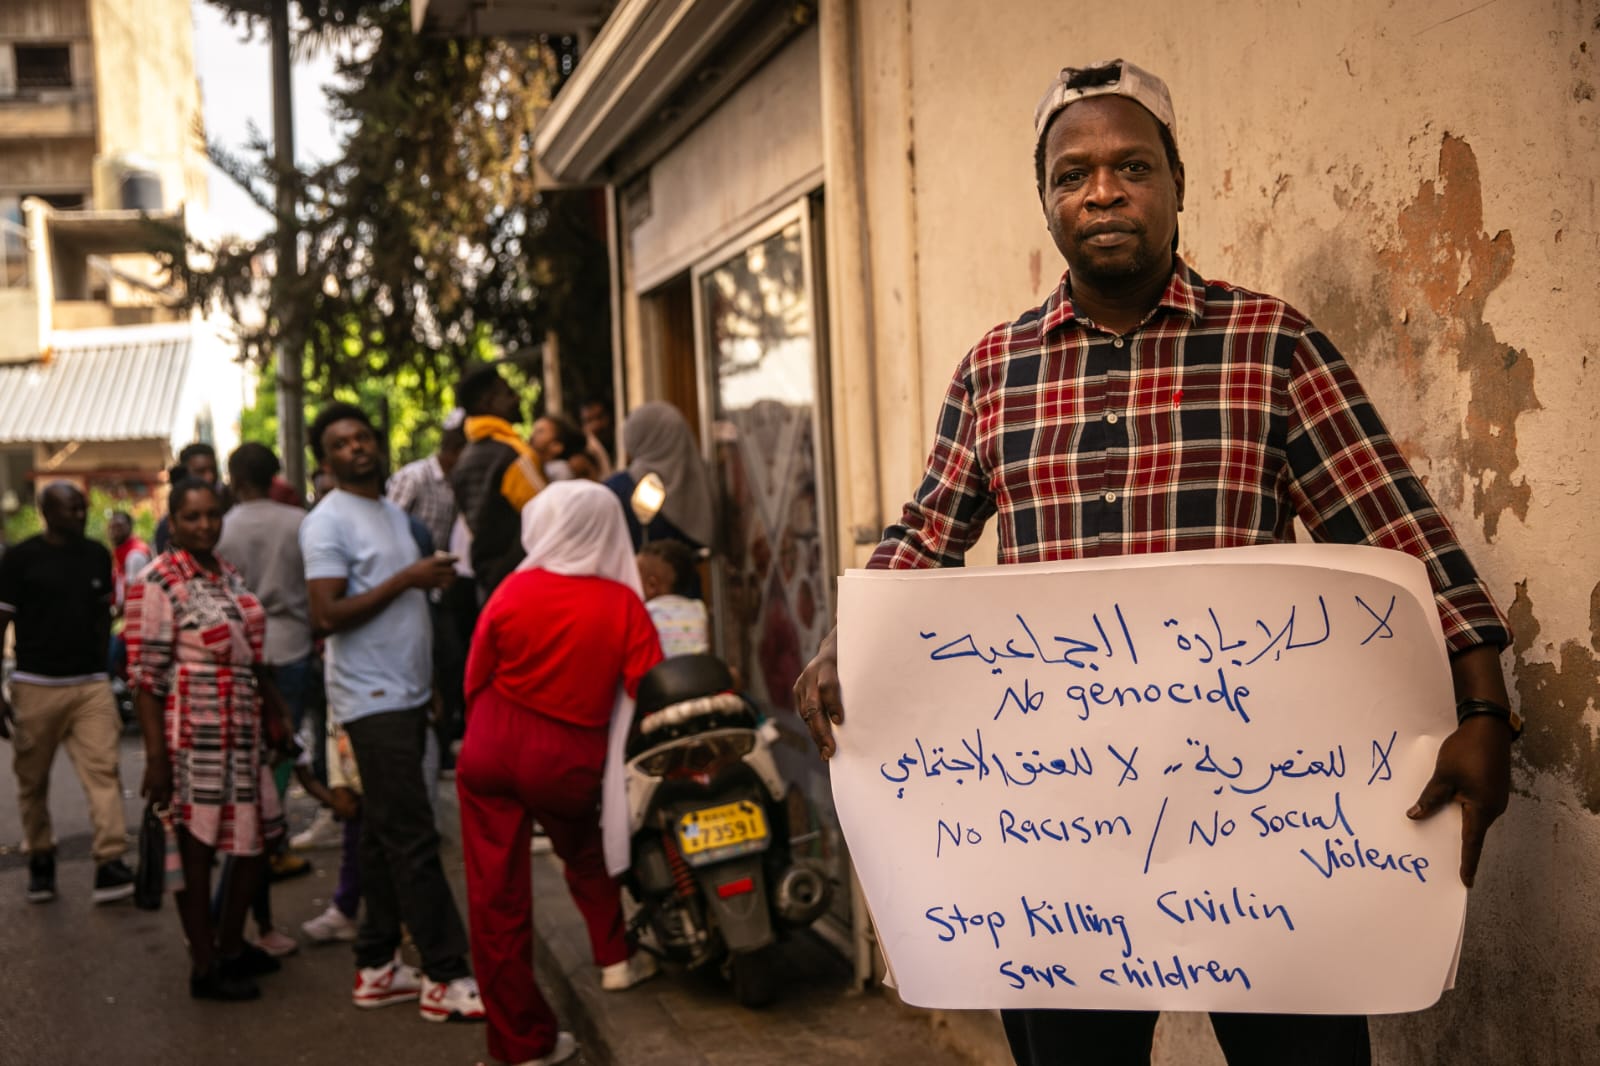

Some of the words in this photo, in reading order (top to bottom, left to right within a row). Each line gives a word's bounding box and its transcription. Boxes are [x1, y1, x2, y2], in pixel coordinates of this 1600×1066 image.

[918, 602, 1139, 675] الجماعية
[1354, 594, 1397, 646] لا
[992, 678, 1046, 721] No
[1065, 667, 1252, 724] genocide
[1107, 744, 1140, 788] لا
[1366, 730, 1398, 786] لا
[935, 818, 983, 859] No
[998, 808, 1133, 845] Racism
[1188, 810, 1237, 848] No
[1249, 791, 1356, 838] Social
[1299, 838, 1431, 884] Violence
[1019, 894, 1134, 959] Killing
[1099, 954, 1253, 991] children
